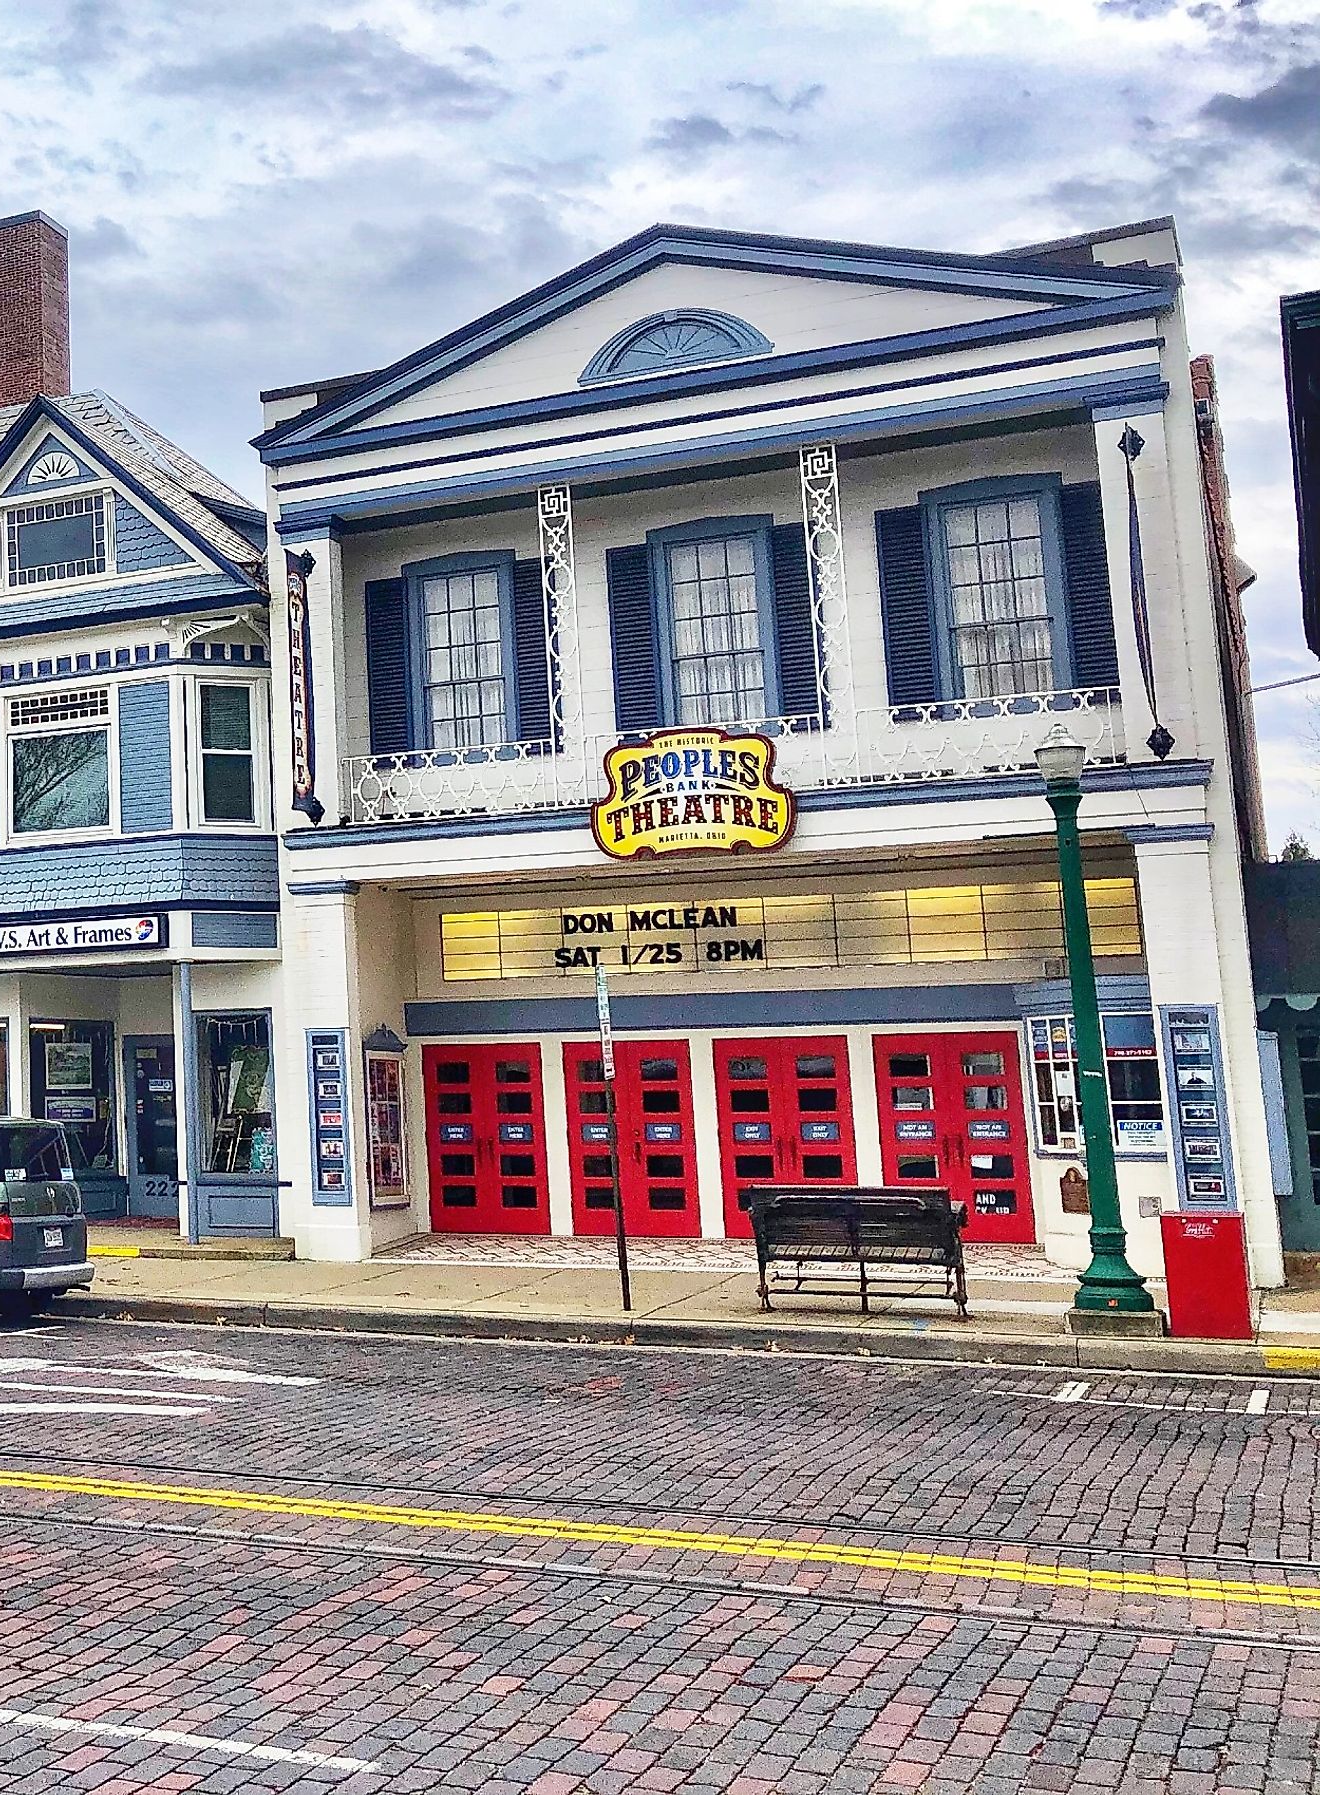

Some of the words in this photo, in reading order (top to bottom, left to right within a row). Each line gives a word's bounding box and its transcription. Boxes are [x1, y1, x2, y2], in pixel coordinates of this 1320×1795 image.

[291, 601, 306, 785] THEATRE
[677, 737, 714, 746] HISTORIC
[618, 748, 760, 803] PEOPLES
[666, 780, 711, 792] BANK
[606, 794, 779, 843] THEATRE
[706, 831, 726, 840] OHIO
[563, 912, 614, 934] DON
[629, 907, 737, 931] MCLEAN
[26, 929, 51, 947] Art
[55, 927, 69, 945] &
[73, 925, 132, 944] Frames
[555, 946, 601, 968] SAT
[621, 943, 682, 965] 1/25
[706, 939, 763, 961] 8PM
[1123, 1122, 1158, 1130] NOTICE
[976, 1193, 996, 1204] AND
